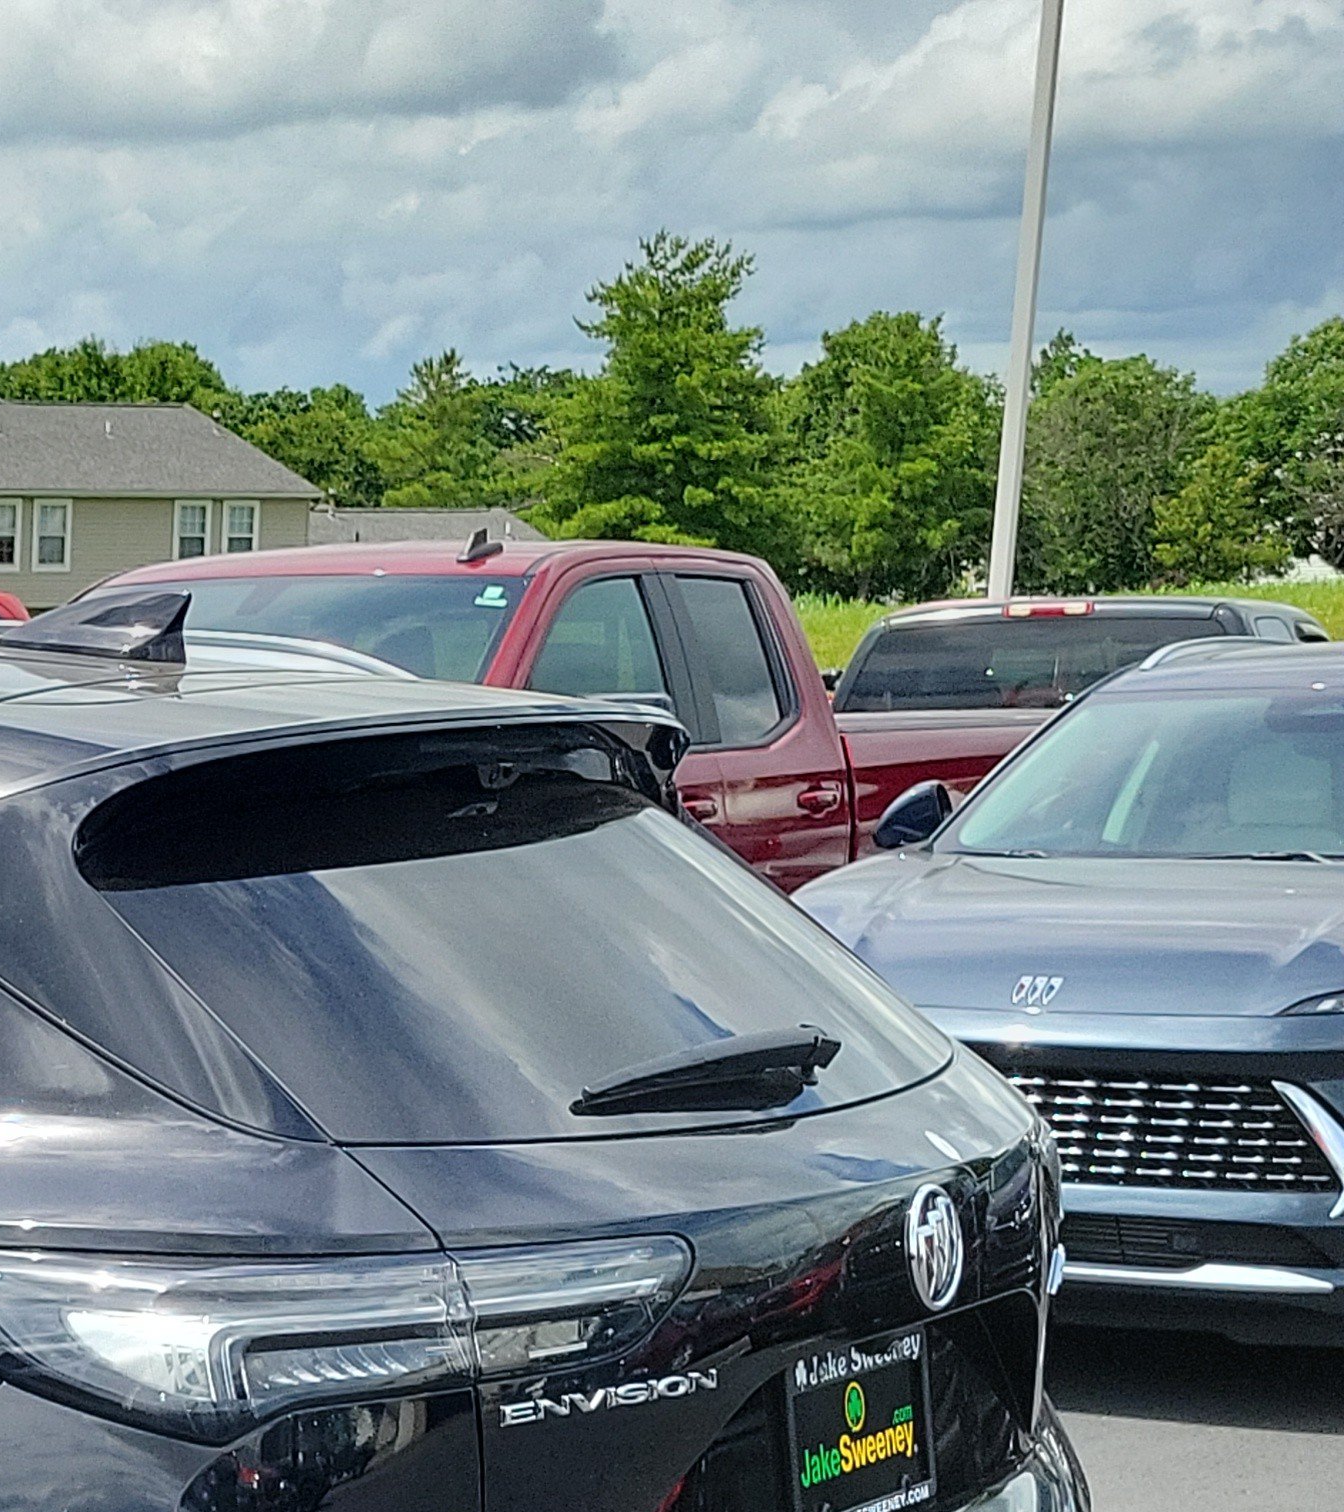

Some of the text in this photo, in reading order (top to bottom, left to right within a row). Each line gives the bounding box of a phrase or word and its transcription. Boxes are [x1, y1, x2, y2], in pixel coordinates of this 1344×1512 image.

[499, 1367, 718, 1429] ENVISION
[808, 1351, 848, 1386] Jake
[800, 1420, 914, 1488] JakeSweeney
